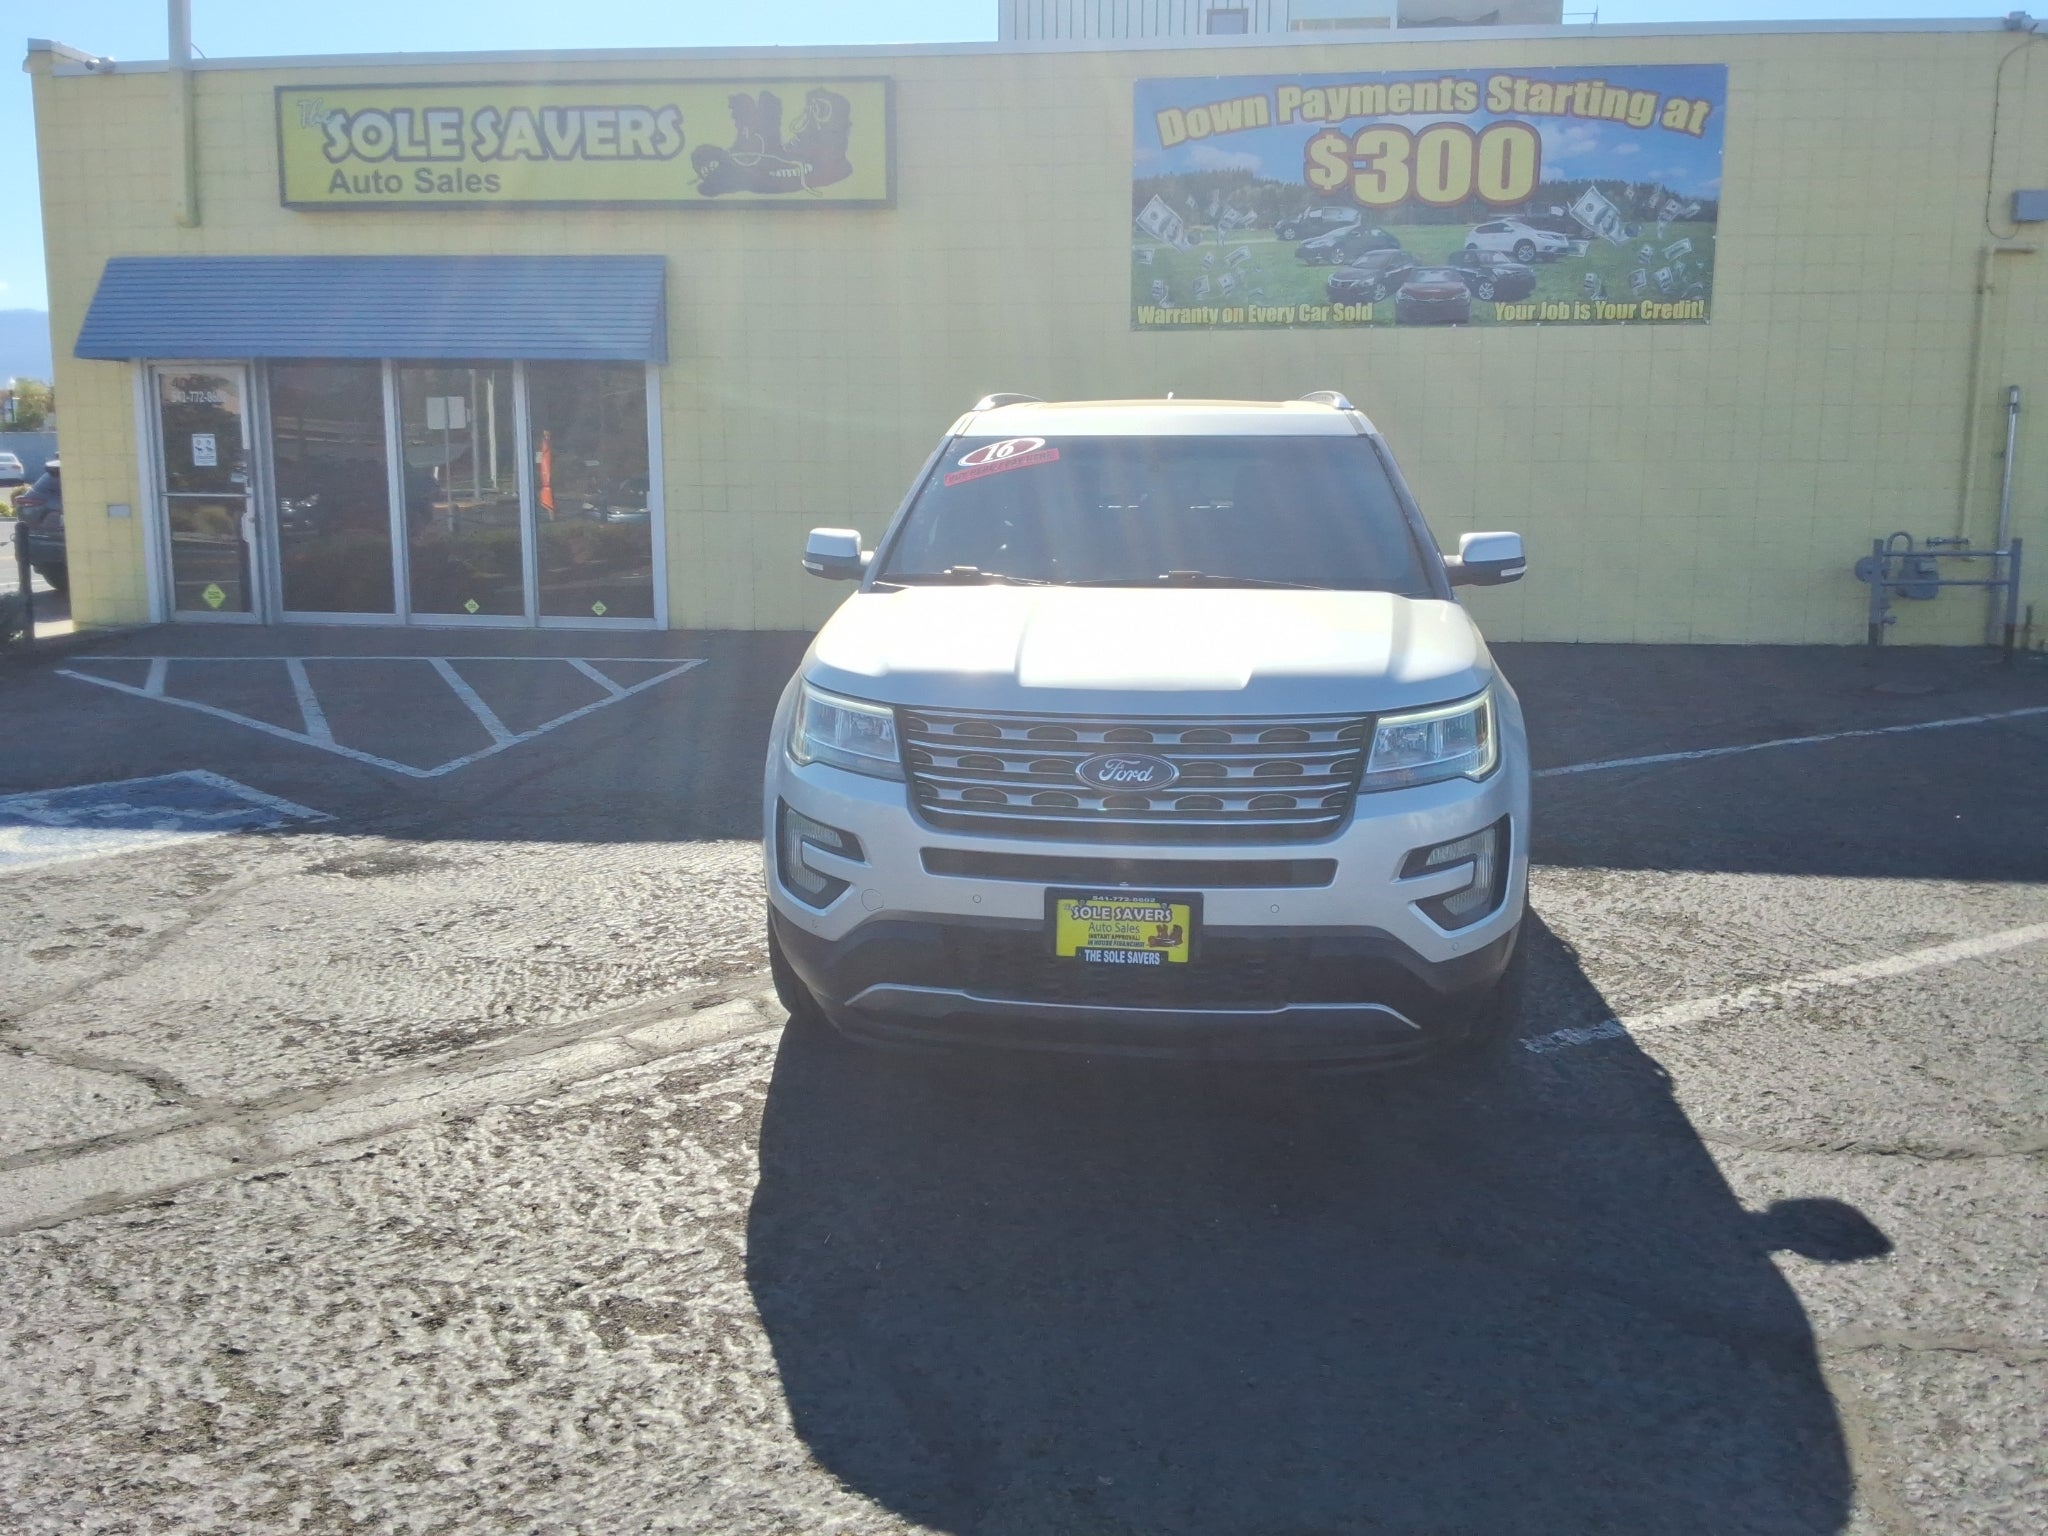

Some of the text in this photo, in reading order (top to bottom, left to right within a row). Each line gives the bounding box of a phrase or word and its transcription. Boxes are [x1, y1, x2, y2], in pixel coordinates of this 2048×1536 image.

[1156, 74, 1711, 149] Down Payments Starting at
[322, 105, 685, 163] SOLE SAVERS
[1303, 121, 1541, 207] $300
[328, 166, 501, 194] Auto Sales
[1137, 302, 1373, 324] Warranty on Every Car Sold
[1495, 299, 1705, 321] Your Job is Your Credit!
[983, 440, 1016, 460] 16
[1098, 759, 1154, 782] Ford
[1071, 905, 1173, 922] SOLE SAVERS
[1089, 921, 1140, 934] Auto Sales
[1085, 950, 1161, 965] THE SOLE SAVERS
